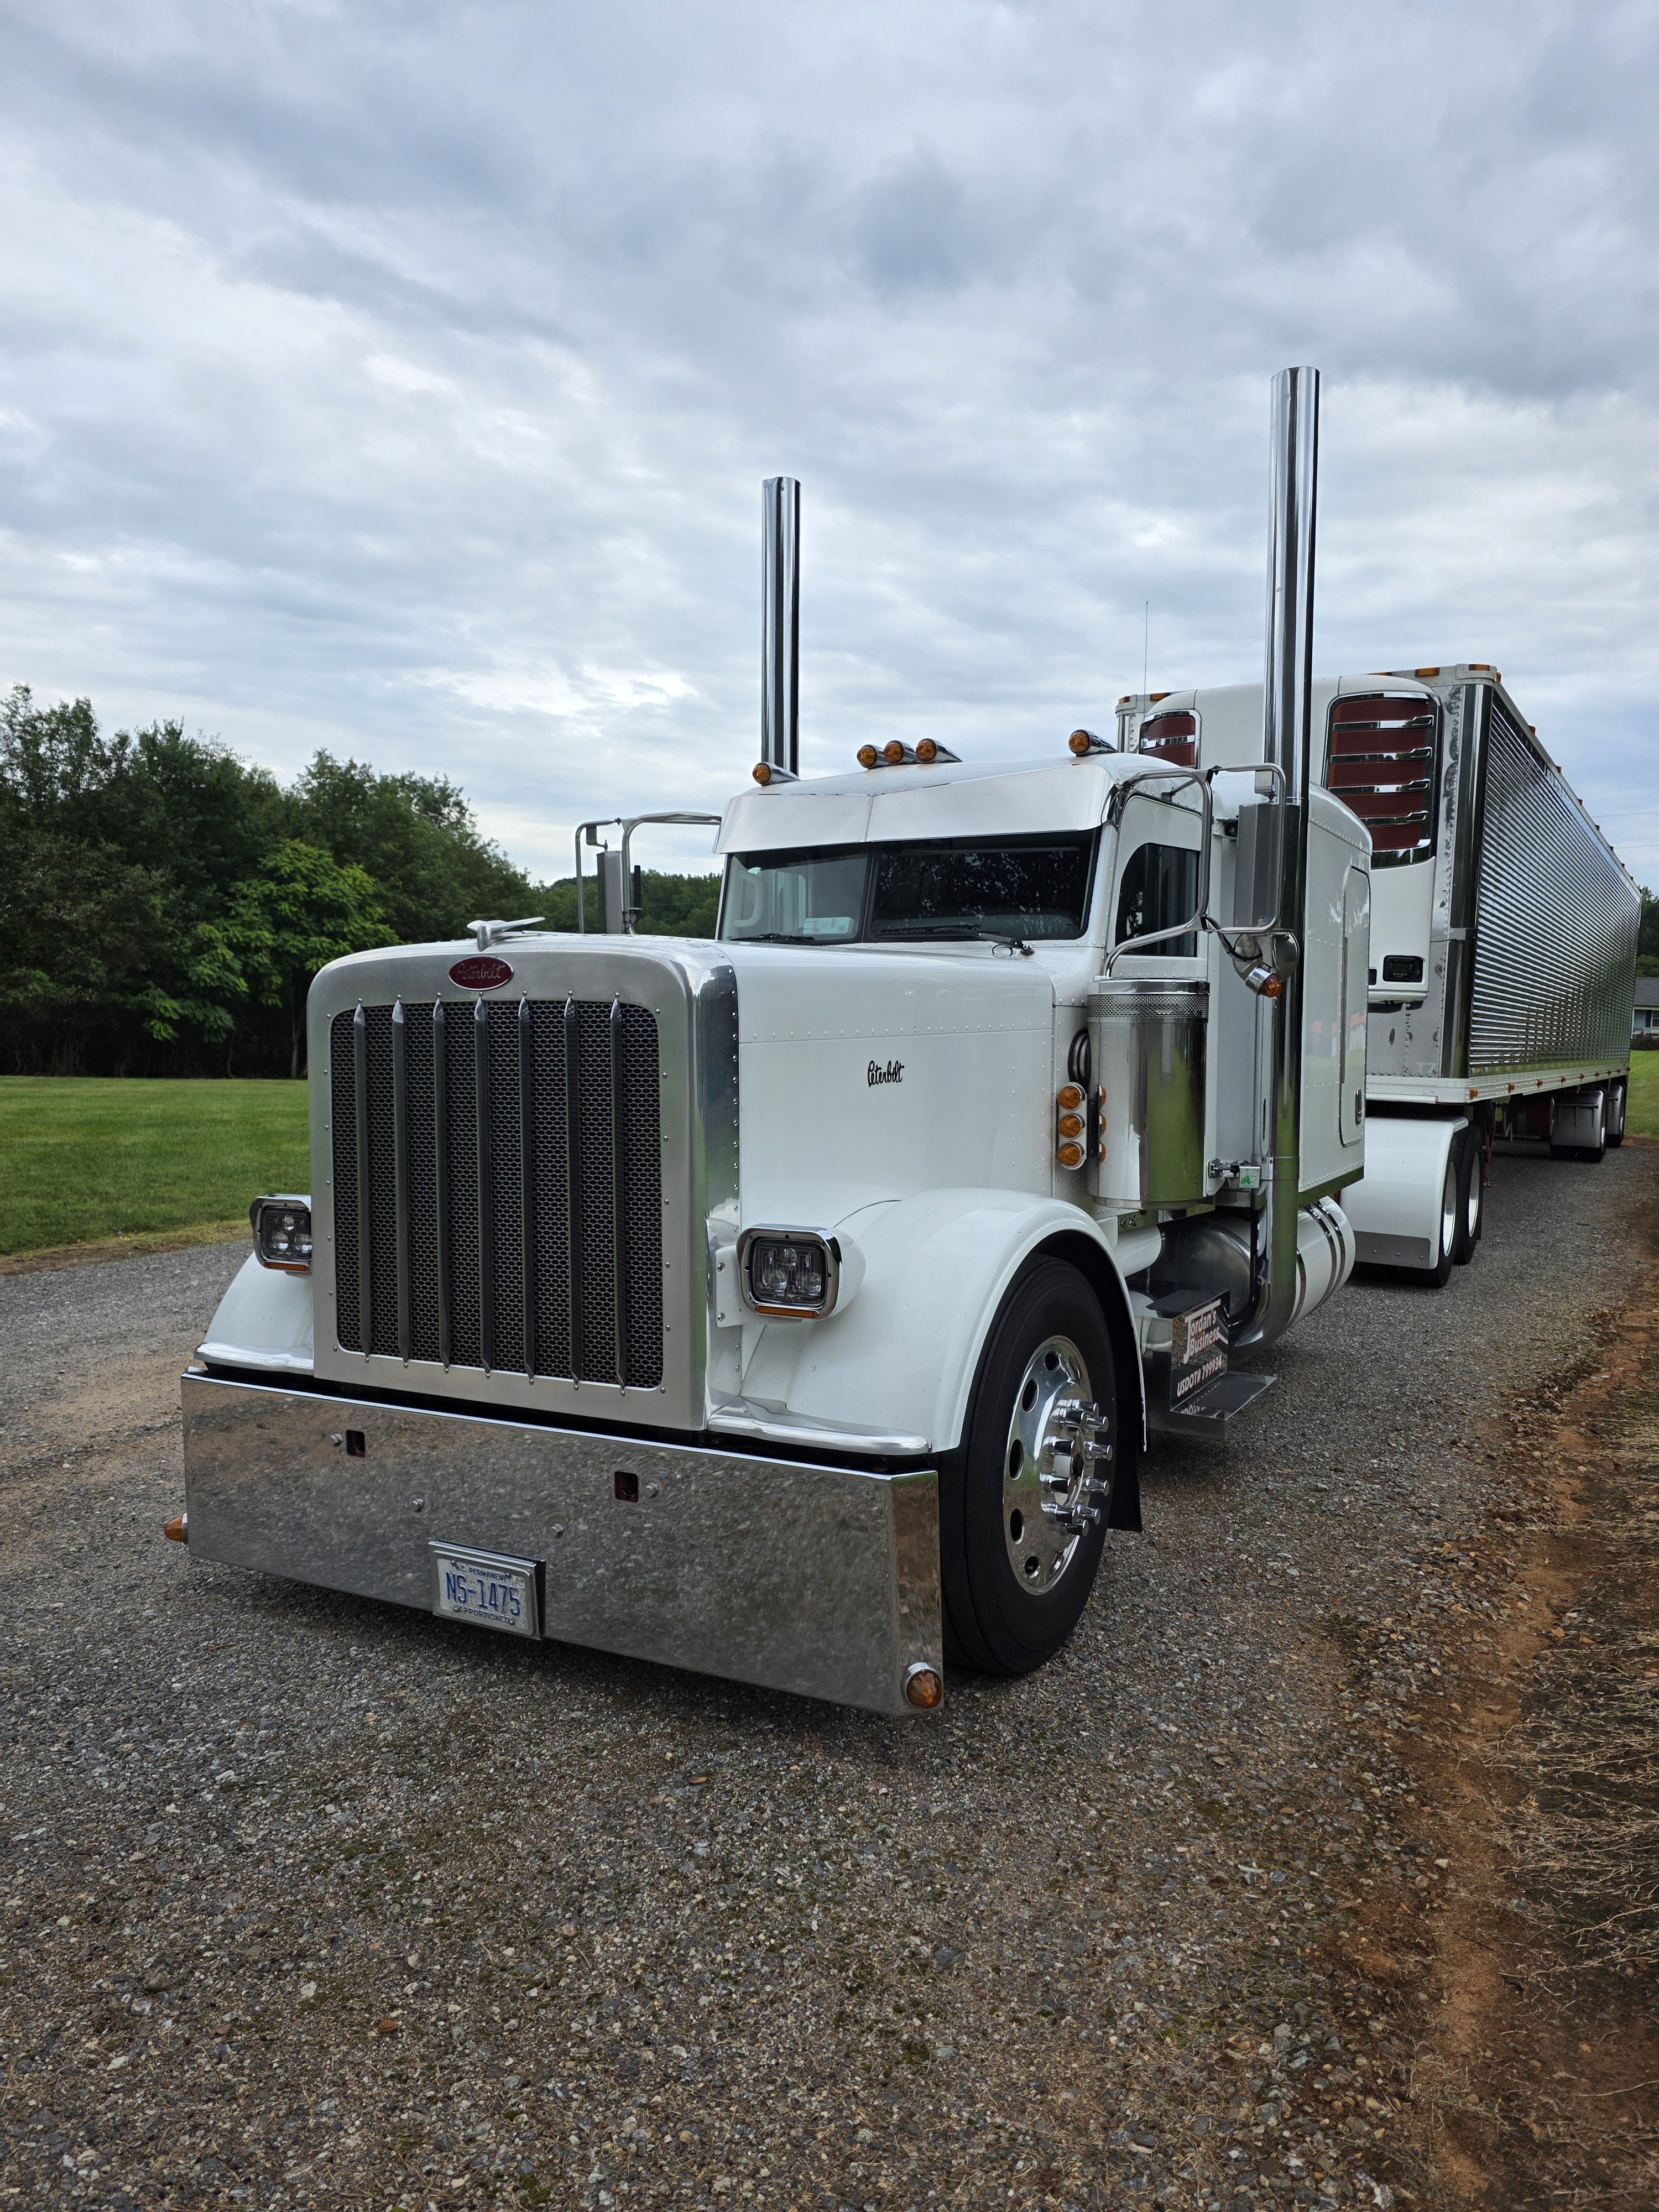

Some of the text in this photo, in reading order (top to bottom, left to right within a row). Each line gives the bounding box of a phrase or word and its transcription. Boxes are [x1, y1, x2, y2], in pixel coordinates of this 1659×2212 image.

[457, 962, 505, 982] Peterbilt
[867, 1060, 905, 1088] Peterbilt
[1184, 1298, 1221, 1364] Jordan's
[1190, 1326, 1220, 1357] Business
[1177, 1368, 1201, 1398] USDOT#
[468, 1566, 507, 1582] PERMANENT
[446, 1571, 520, 1617] NS-1475
[459, 1605, 510, 1624] APPORTIONED
